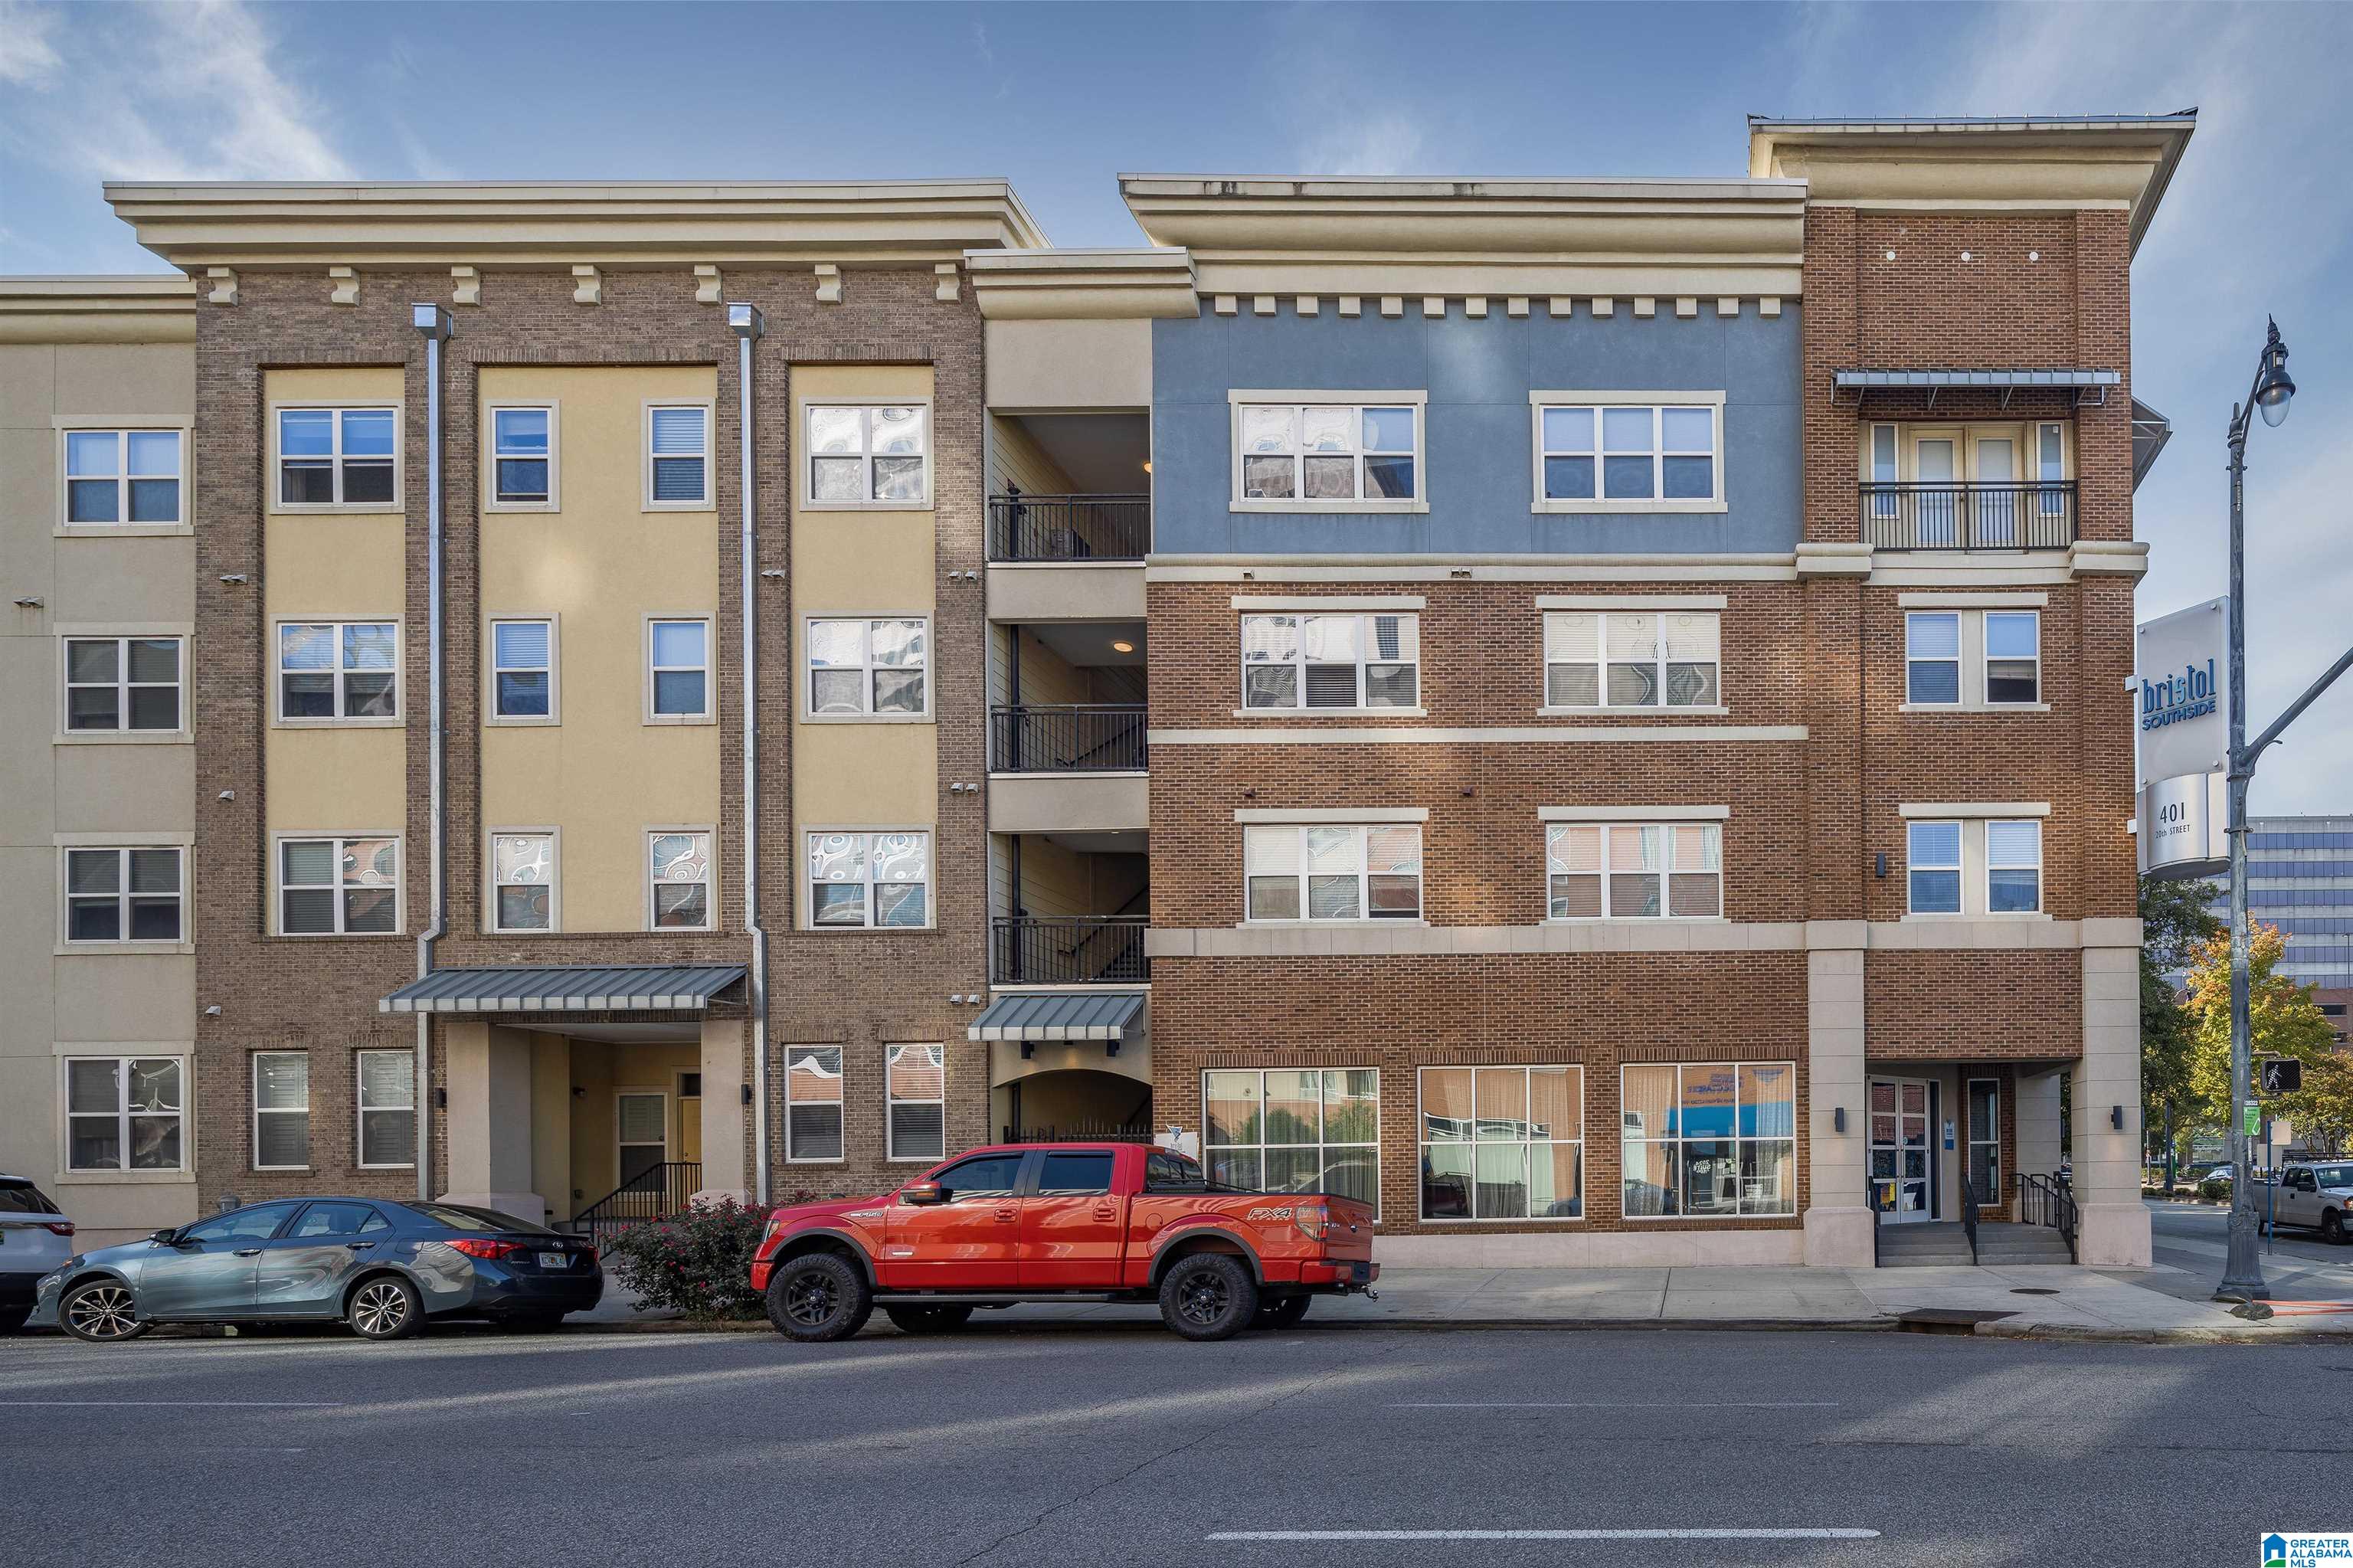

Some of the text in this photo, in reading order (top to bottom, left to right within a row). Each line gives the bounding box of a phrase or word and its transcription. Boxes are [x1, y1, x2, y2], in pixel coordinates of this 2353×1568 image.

[2142, 658, 2216, 715] bristol
[2142, 700, 2216, 731] SOUTHSIDE
[2160, 802, 2184, 823] 401
[2155, 824, 2190, 839] 20th STREET
[1247, 1207, 1293, 1219] FX4
